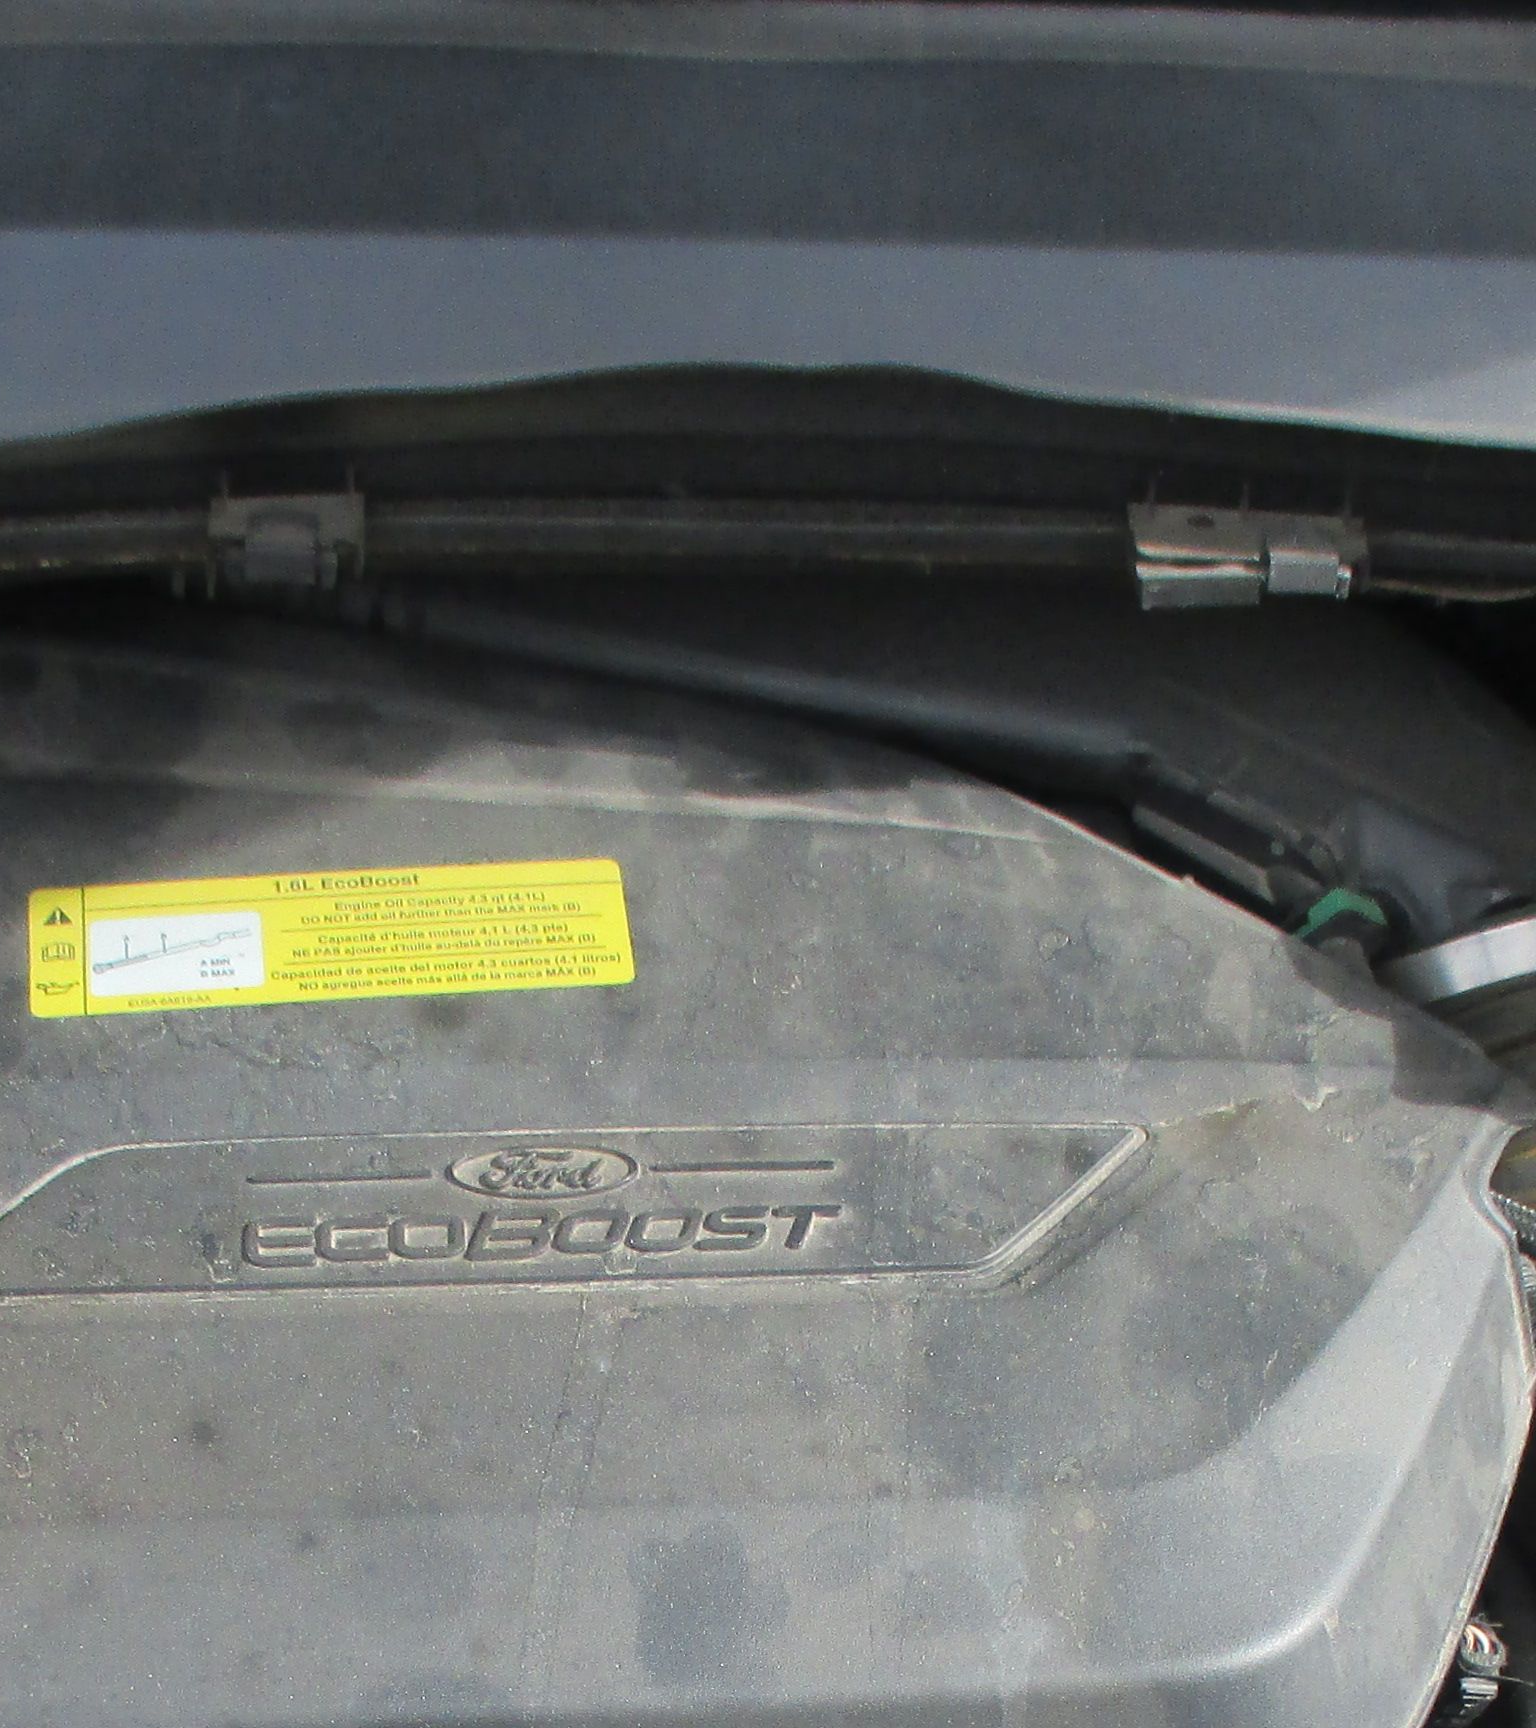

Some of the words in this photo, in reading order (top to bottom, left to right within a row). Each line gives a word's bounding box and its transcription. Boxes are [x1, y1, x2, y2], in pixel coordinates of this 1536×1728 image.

[320, 873, 418, 890] EcoBoost
[323, 913, 350, 923] NOT
[353, 911, 378, 921] add
[399, 908, 440, 919] further
[444, 907, 472, 917] than
[474, 906, 494, 916] the
[497, 904, 525, 914] MAX
[334, 900, 381, 912] Engine
[384, 898, 404, 908] Oil
[407, 895, 465, 908] Capacity
[344, 944, 388, 956] ajouter
[546, 933, 575, 944] MAX
[270, 967, 344, 981] Capacidad
[346, 965, 363, 976] de
[366, 964, 406, 975] aceite
[410, 962, 429, 972] del
[433, 960, 473, 971] motor
[500, 957, 551, 968] cuartos
[582, 952, 621, 964] litros)
[376, 976, 413, 987] aceite
[471, 971, 486, 981] de
[489, 970, 501, 980] la
[504, 968, 543, 979] marca
[478, 1150, 604, 1191] Ford
[242, 1203, 845, 1268] ECOBOOST
